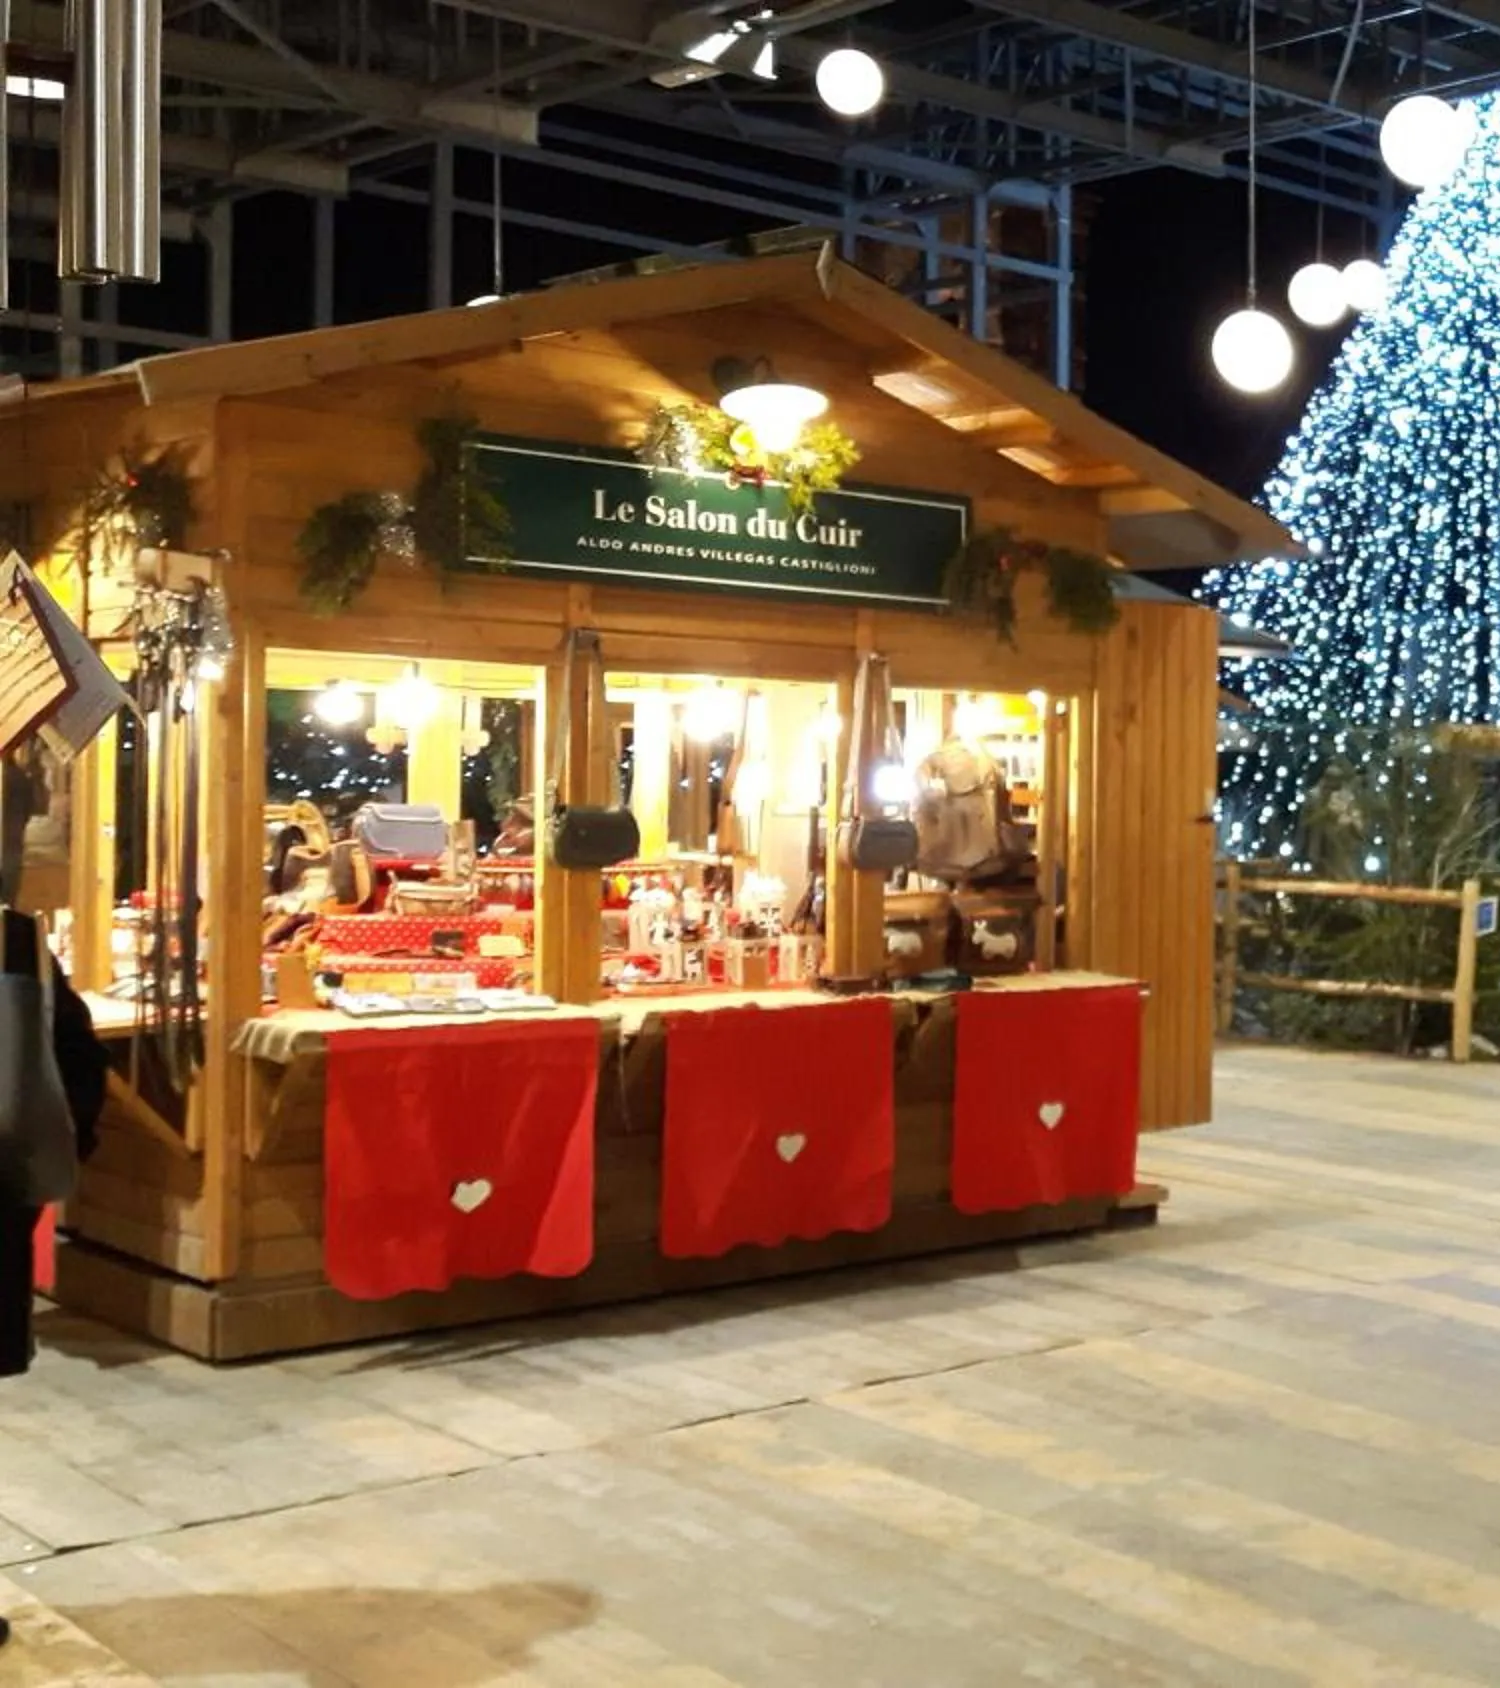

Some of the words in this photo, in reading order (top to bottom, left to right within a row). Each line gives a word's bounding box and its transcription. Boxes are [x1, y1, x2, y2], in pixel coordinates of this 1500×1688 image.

[593, 488, 636, 524] Le
[645, 495, 738, 535] Salon
[746, 508, 789, 541] du
[795, 512, 863, 548] Cuir
[576, 535, 624, 550] ALDO
[629, 541, 696, 558] ANDRES
[700, 548, 776, 566] VILLEGAS
[779, 556, 877, 575] CASTIGLIONI
